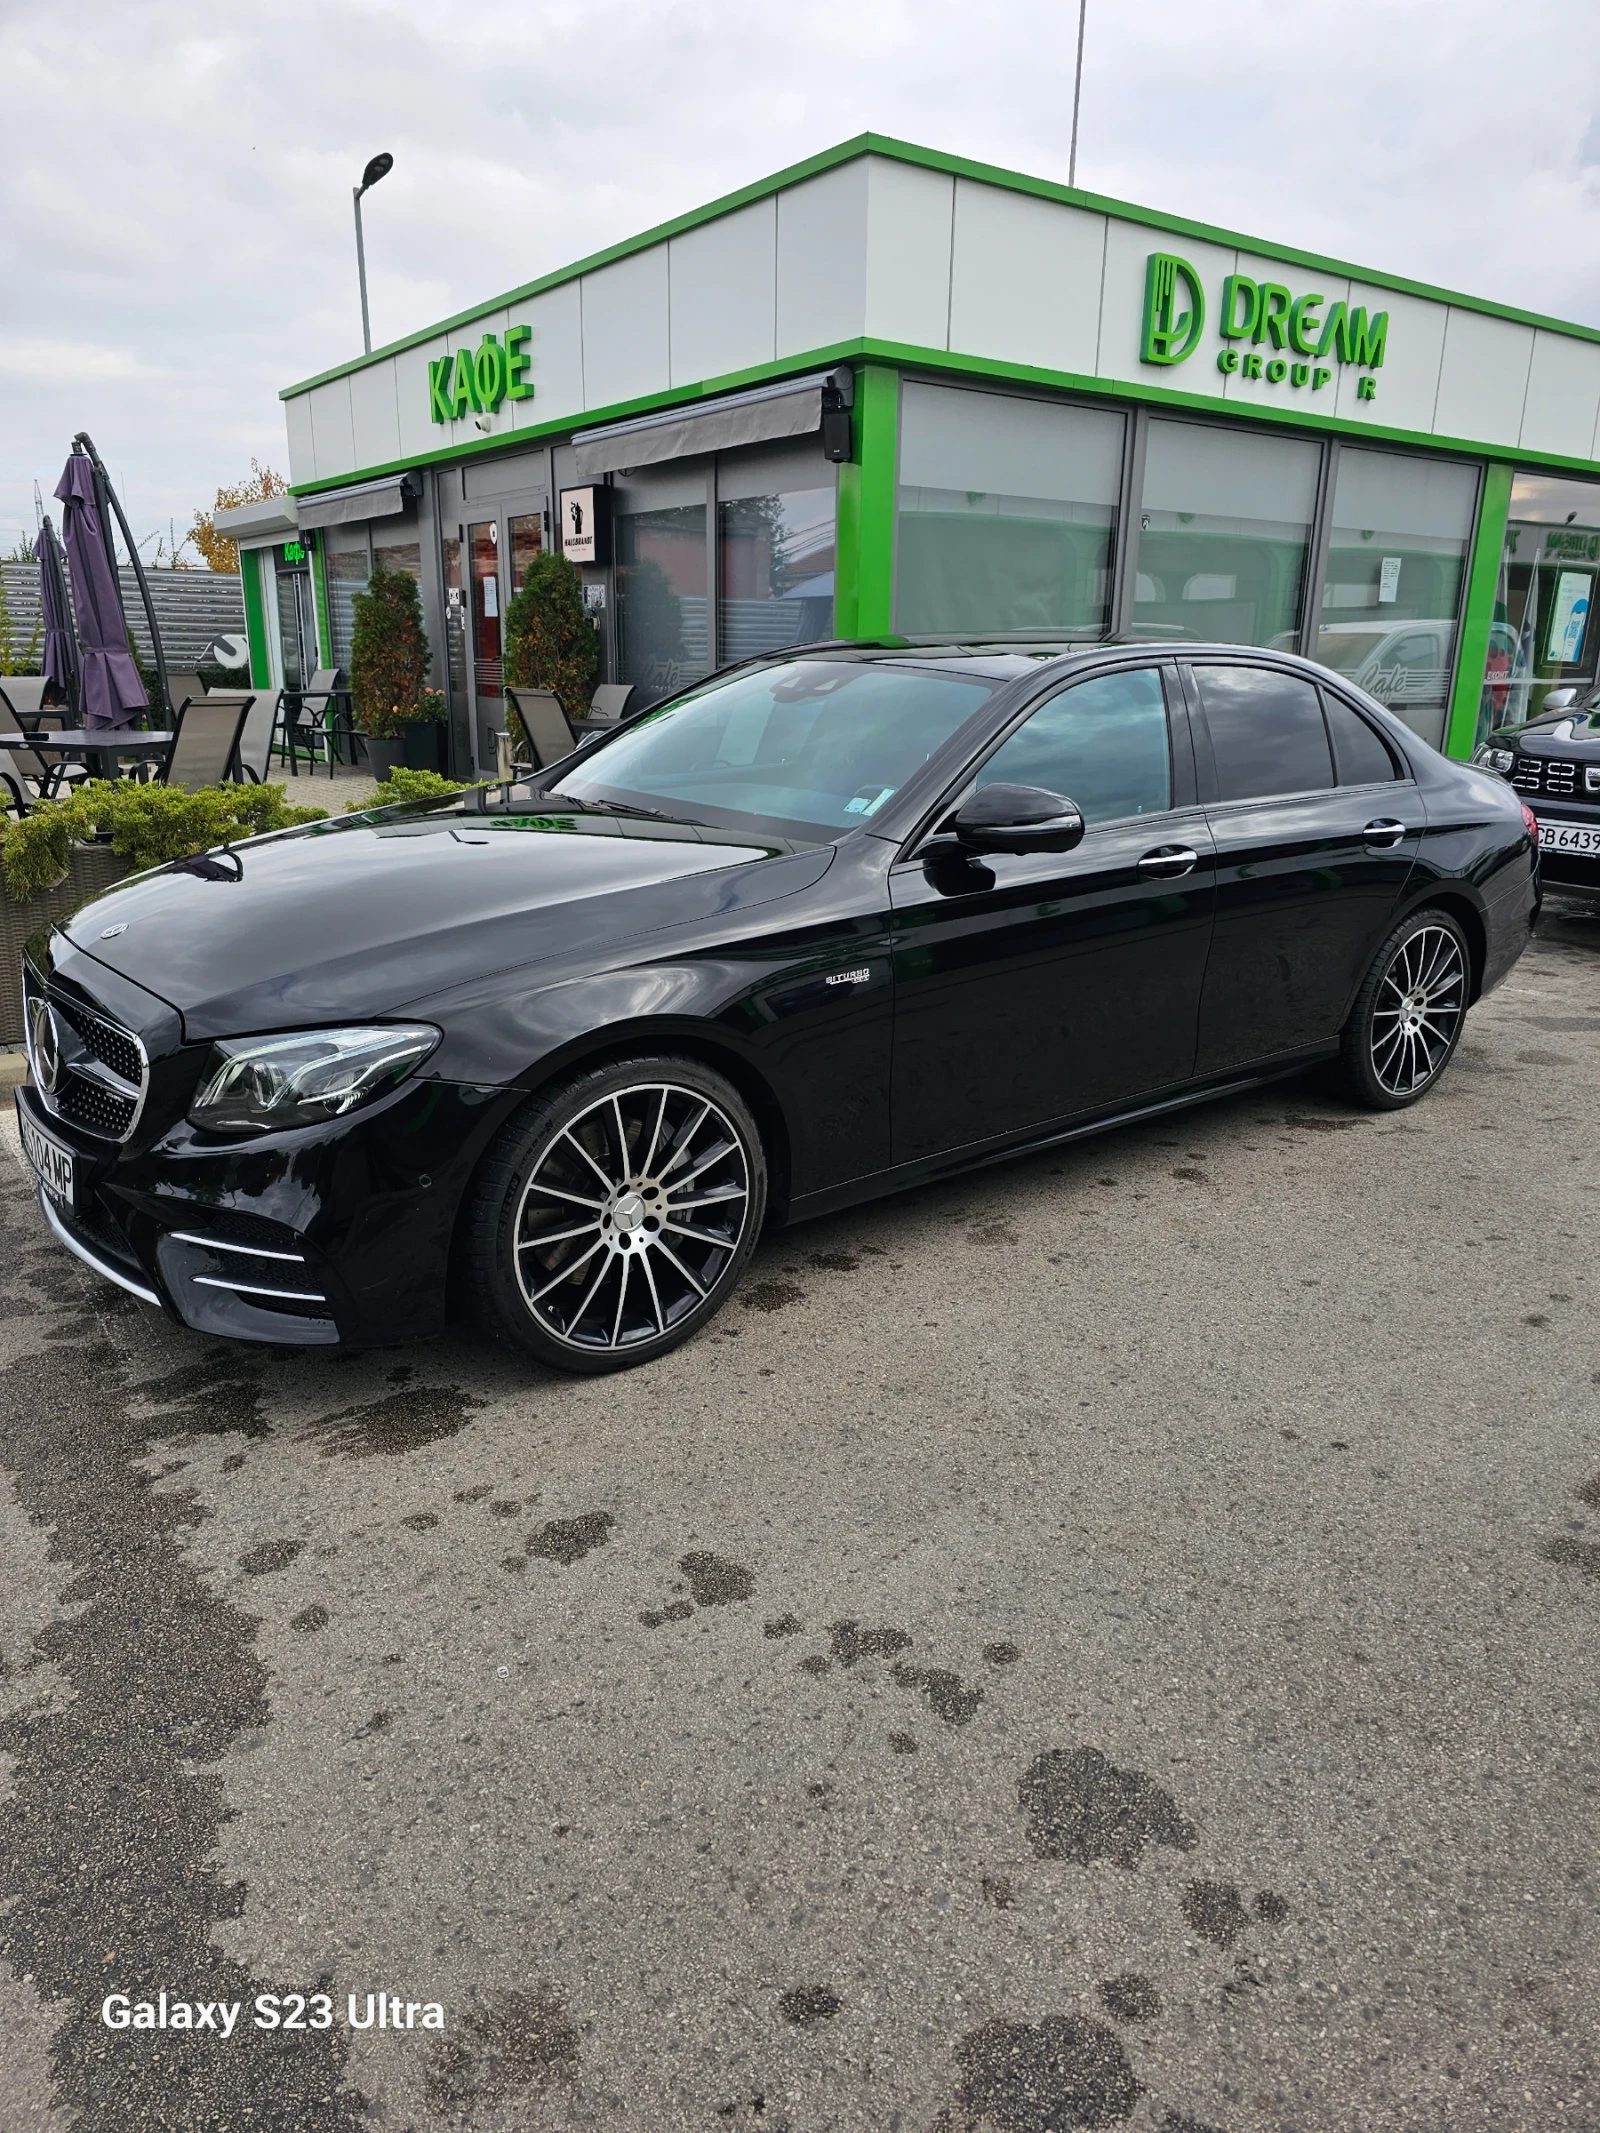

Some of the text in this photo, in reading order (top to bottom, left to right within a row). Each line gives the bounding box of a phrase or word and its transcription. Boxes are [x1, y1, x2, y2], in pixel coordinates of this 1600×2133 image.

[1219, 274, 1390, 369] DREAM
[428, 324, 535, 424] КАФЕ
[1217, 348, 1377, 400] GROUP R
